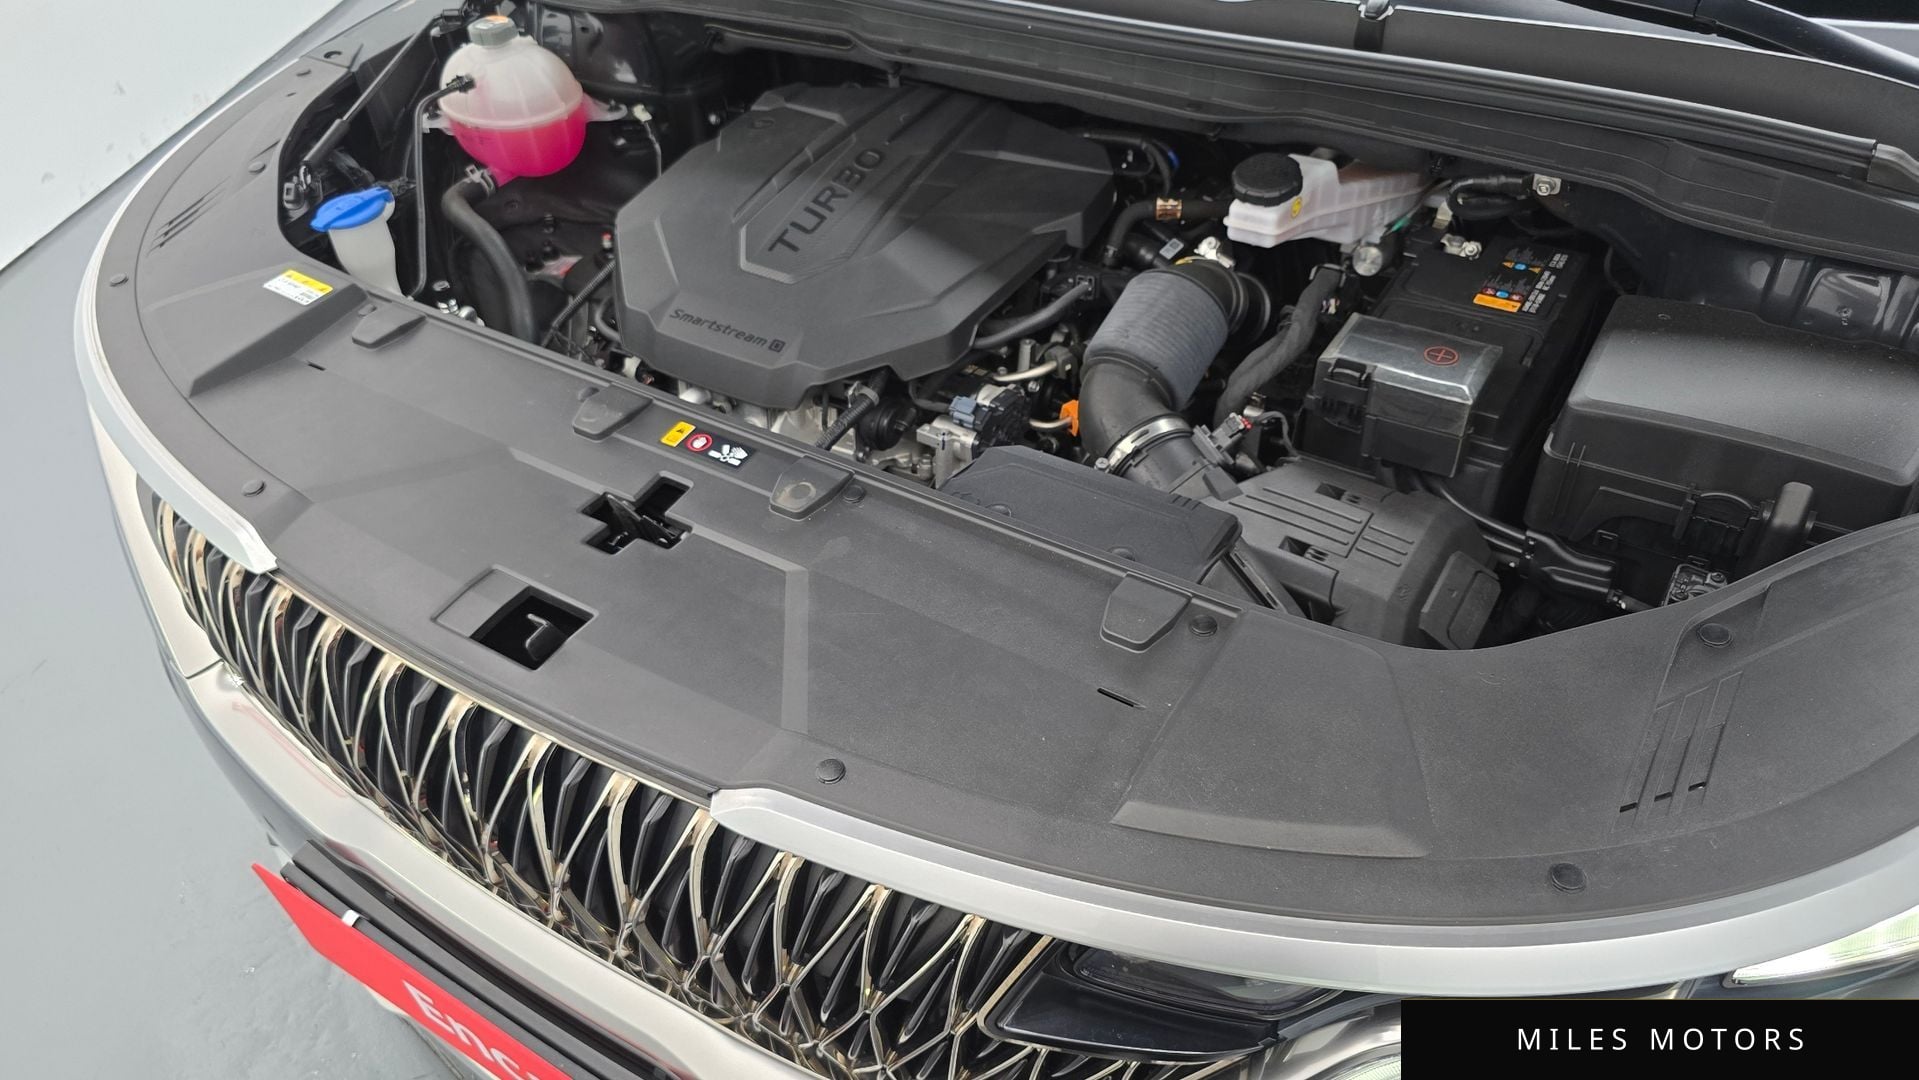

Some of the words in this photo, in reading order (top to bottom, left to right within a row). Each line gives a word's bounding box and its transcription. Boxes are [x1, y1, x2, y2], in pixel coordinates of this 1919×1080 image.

[768, 149, 884, 252] TURBO
[669, 308, 768, 347] Smartstream
[402, 979, 541, 1080] Enc
